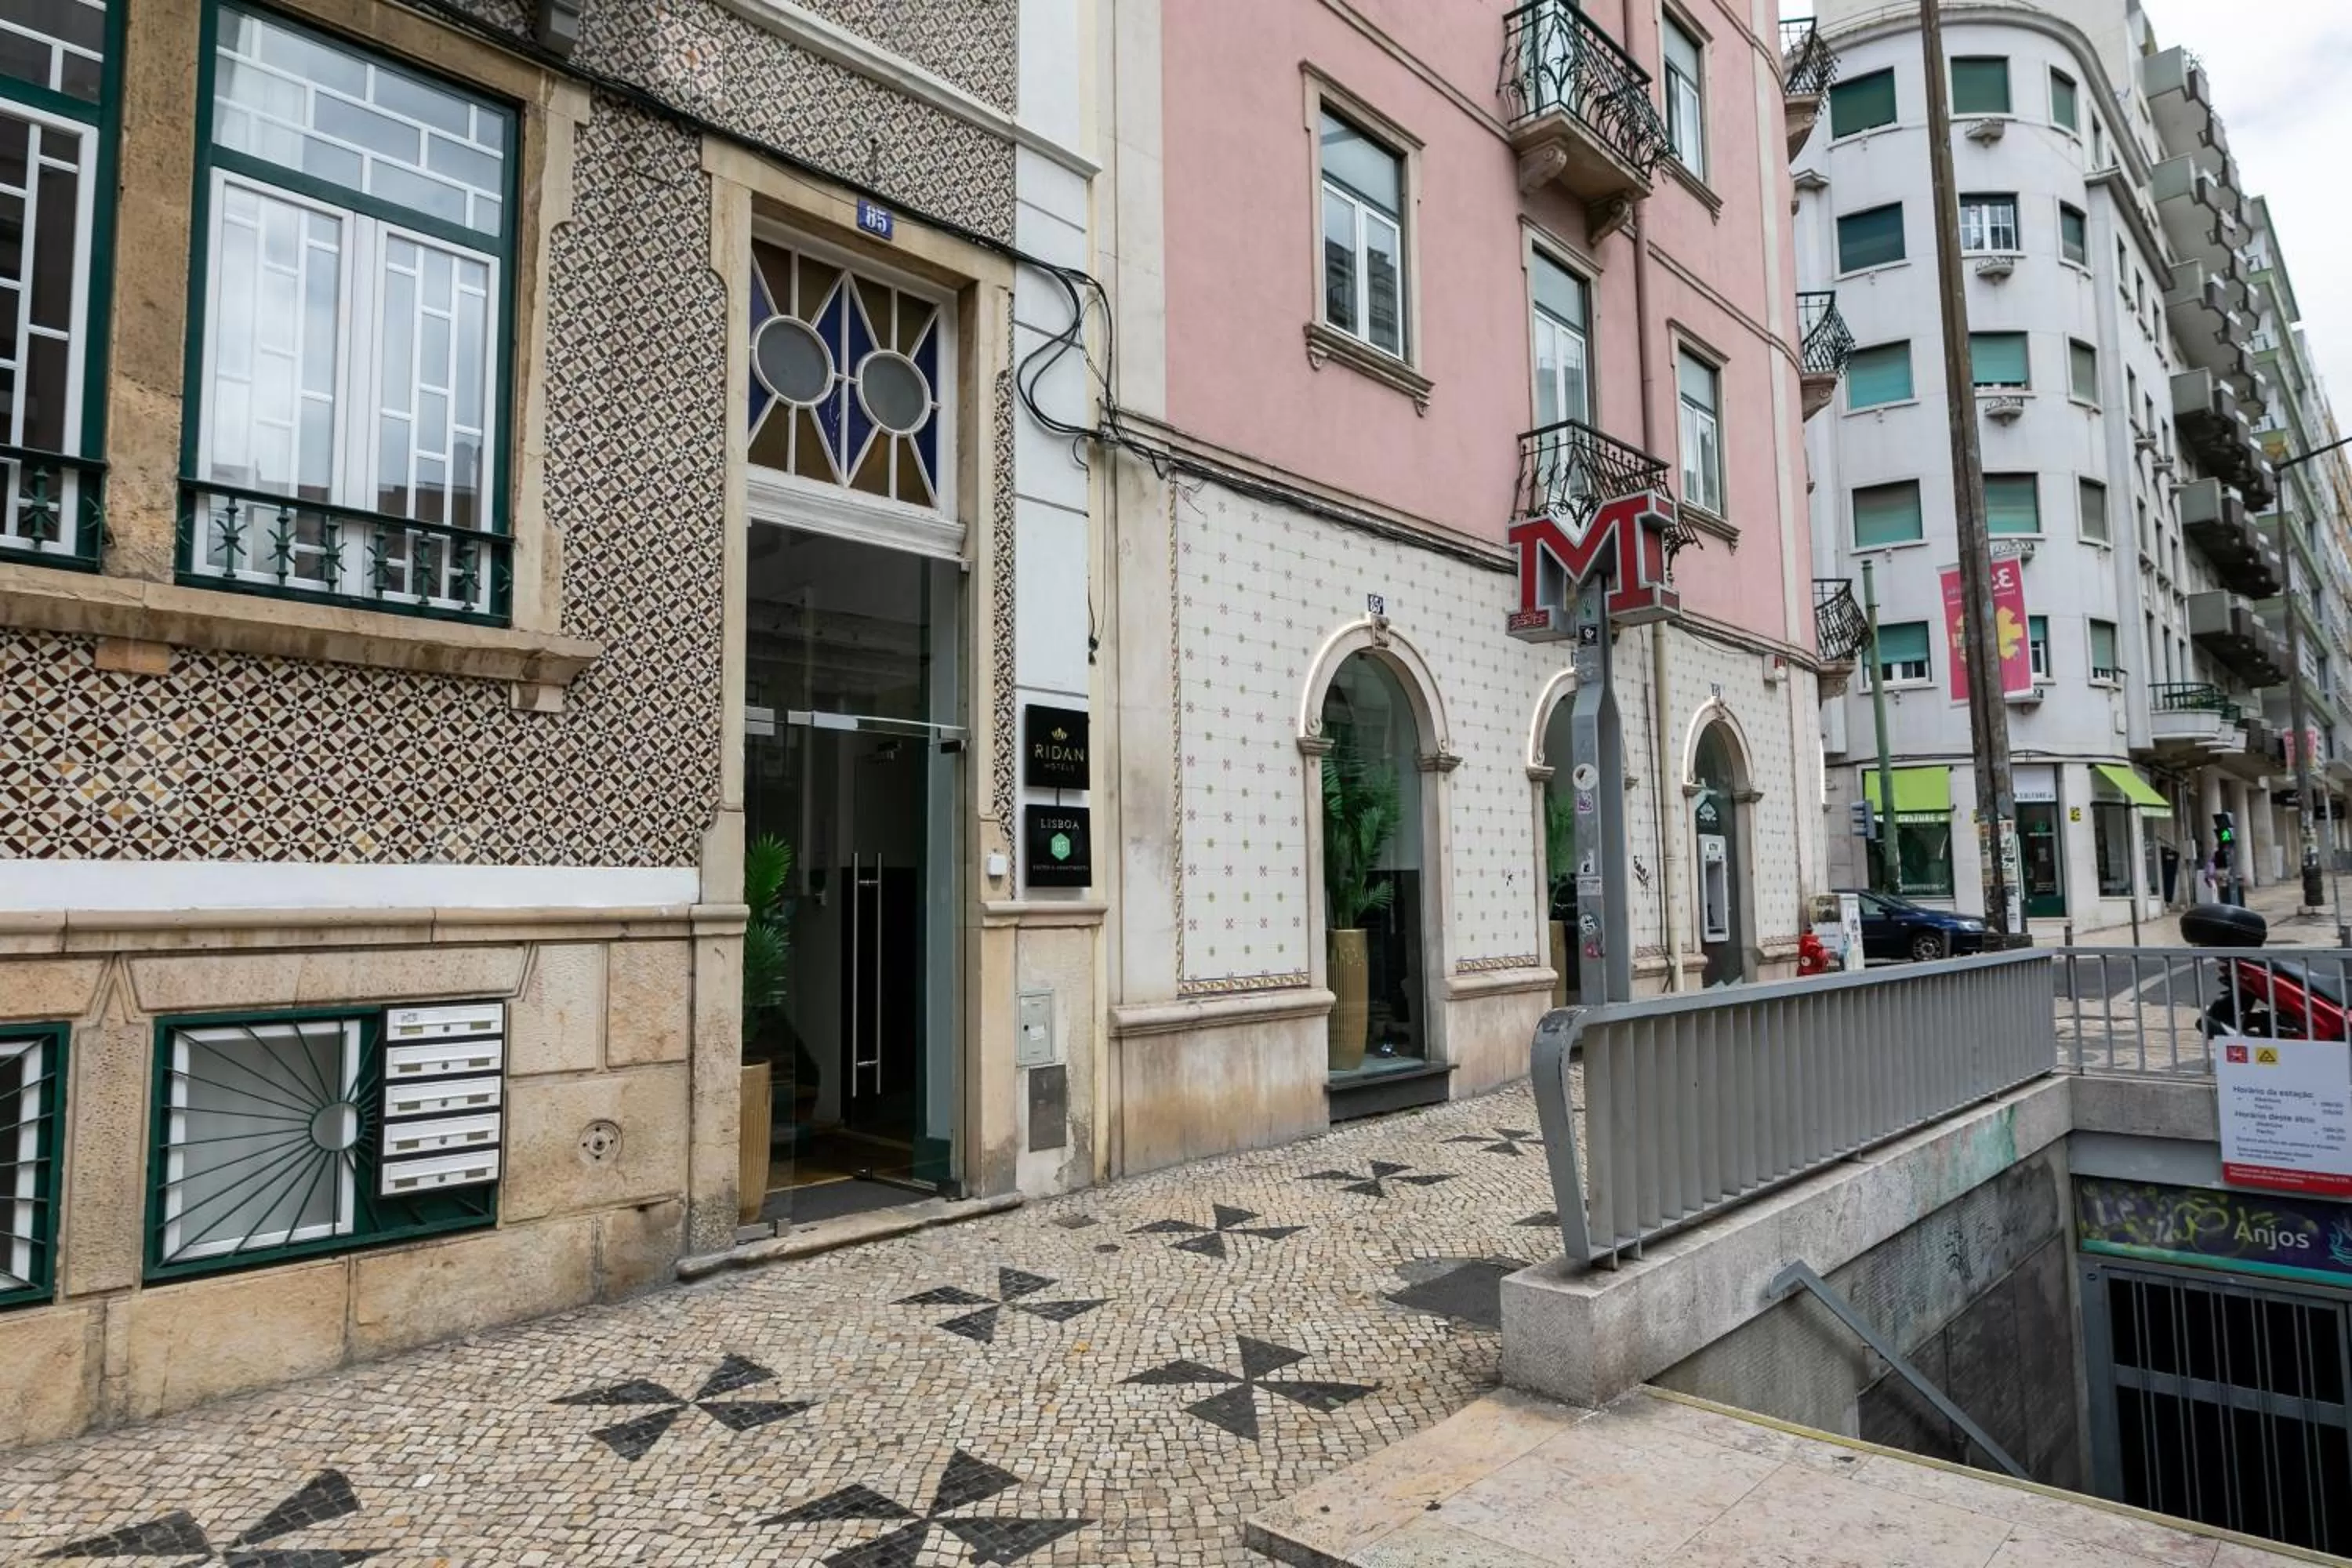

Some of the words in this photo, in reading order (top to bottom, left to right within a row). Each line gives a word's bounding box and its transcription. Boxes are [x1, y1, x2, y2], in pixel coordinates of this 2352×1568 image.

[866, 205, 887, 233] 85
[1033, 743, 1086, 763] RIDAN
[1040, 818, 1080, 830] LISBOA
[2234, 1220, 2310, 1250] Anjos
